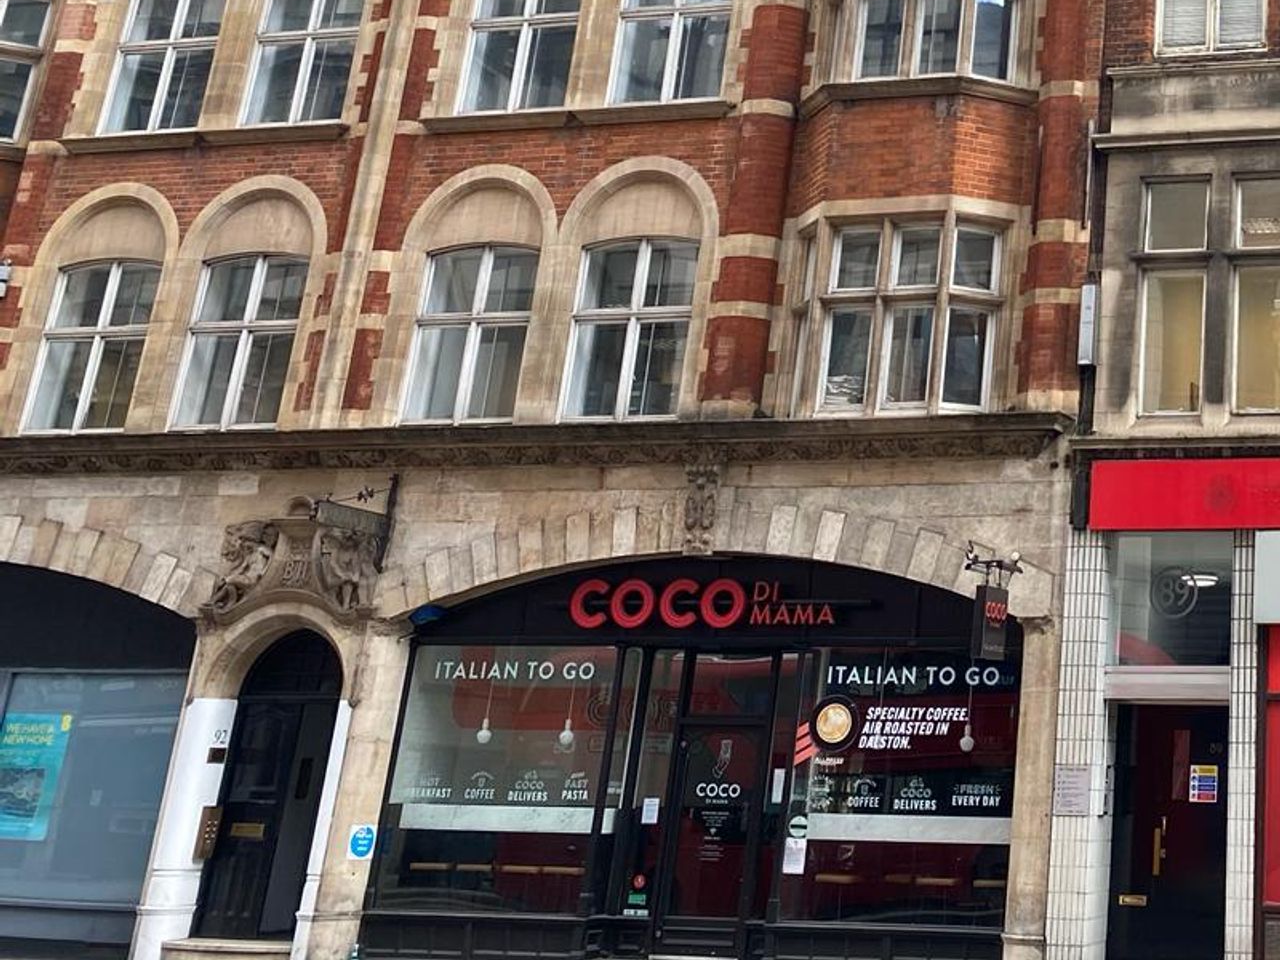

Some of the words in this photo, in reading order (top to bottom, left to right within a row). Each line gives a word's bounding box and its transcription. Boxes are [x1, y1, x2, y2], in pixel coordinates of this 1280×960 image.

[570, 578, 747, 629] COCO
[753, 581, 779, 602] DI
[750, 604, 835, 625] MAMA
[985, 601, 1007, 620] COCO
[435, 662, 519, 680] ITALIAN
[528, 662, 555, 680] TO
[562, 662, 596, 680] GO
[827, 666, 917, 685] ITALIAN
[926, 666, 956, 686] TO
[965, 666, 1000, 686] GO
[866, 707, 926, 721] SPECIALTY
[926, 707, 969, 721] COFFEE.
[862, 722, 883, 734] AIR
[884, 722, 935, 735] ROASTED
[935, 722, 949, 735] IN
[212, 729, 227, 744] 92
[858, 735, 911, 749] DALSTON.
[515, 780, 544, 790] COCO
[696, 783, 741, 797] COCO
[464, 788, 495, 800] COFFEE
[507, 791, 548, 802] DELIVERS
[561, 790, 589, 801] PASTA
[900, 787, 932, 798] COCO
[847, 796, 880, 808] COFFEE
[893, 799, 937, 811] DELIVERS
[951, 795, 979, 807] EVERY
[982, 796, 1001, 807] DAY
